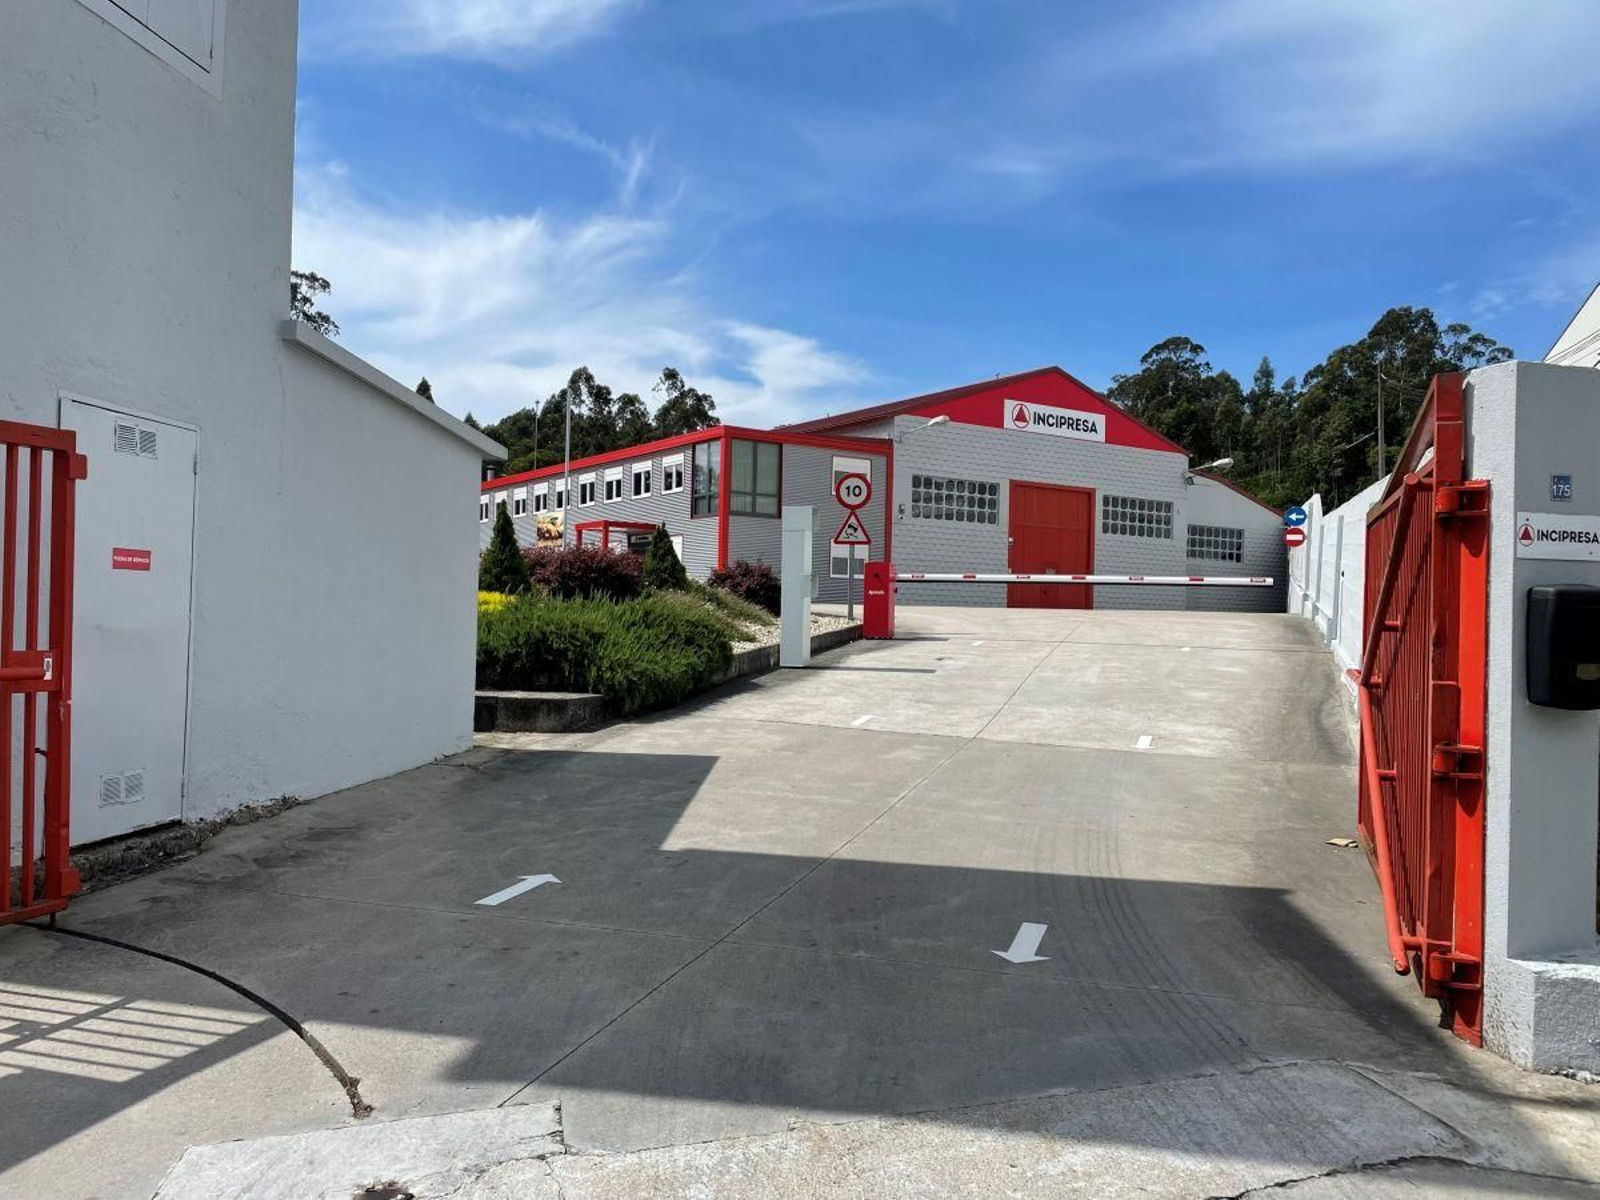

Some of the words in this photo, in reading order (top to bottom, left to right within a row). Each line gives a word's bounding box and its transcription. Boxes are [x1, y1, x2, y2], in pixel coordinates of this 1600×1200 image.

[1033, 411, 1098, 434] INCIPRESA
[845, 485, 862, 497] 10
[1553, 484, 1571, 497] 175
[1536, 529, 1600, 545] INCIPRESA
